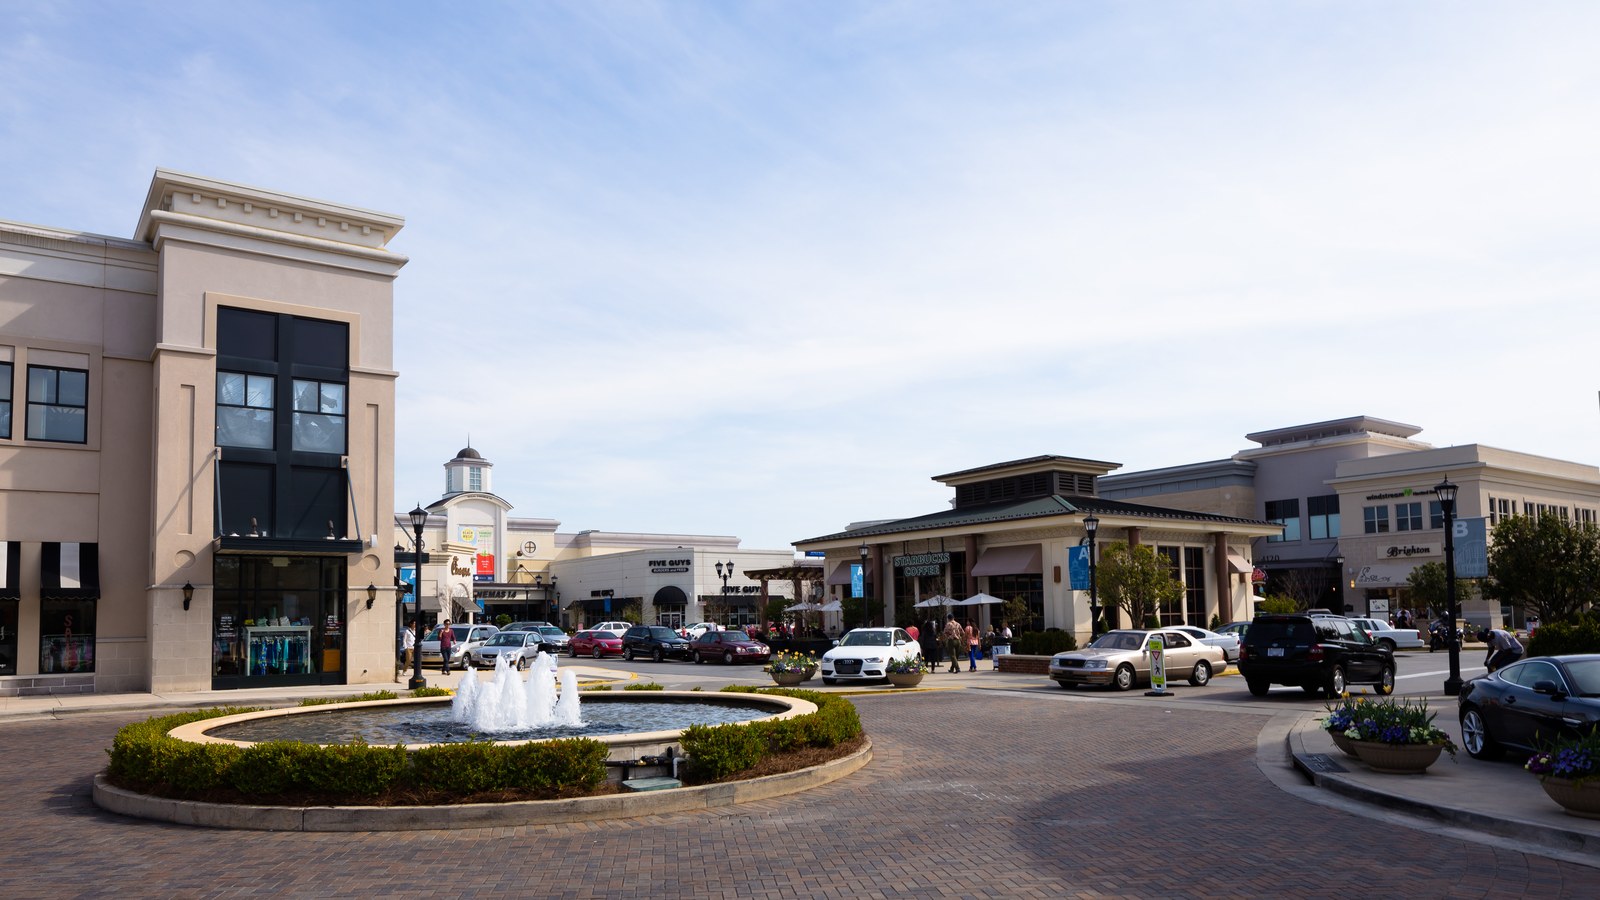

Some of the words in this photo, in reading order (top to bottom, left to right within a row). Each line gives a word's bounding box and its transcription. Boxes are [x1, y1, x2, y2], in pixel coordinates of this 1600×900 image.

[1366, 492, 1404, 500] windstream
[1453, 521, 1469, 537] B
[1079, 547, 1088, 560] A
[1386, 545, 1430, 557] Brighton
[895, 553, 950, 567] STARBUCKS
[857, 566, 863, 576] A
[904, 565, 940, 577] COFFEE
